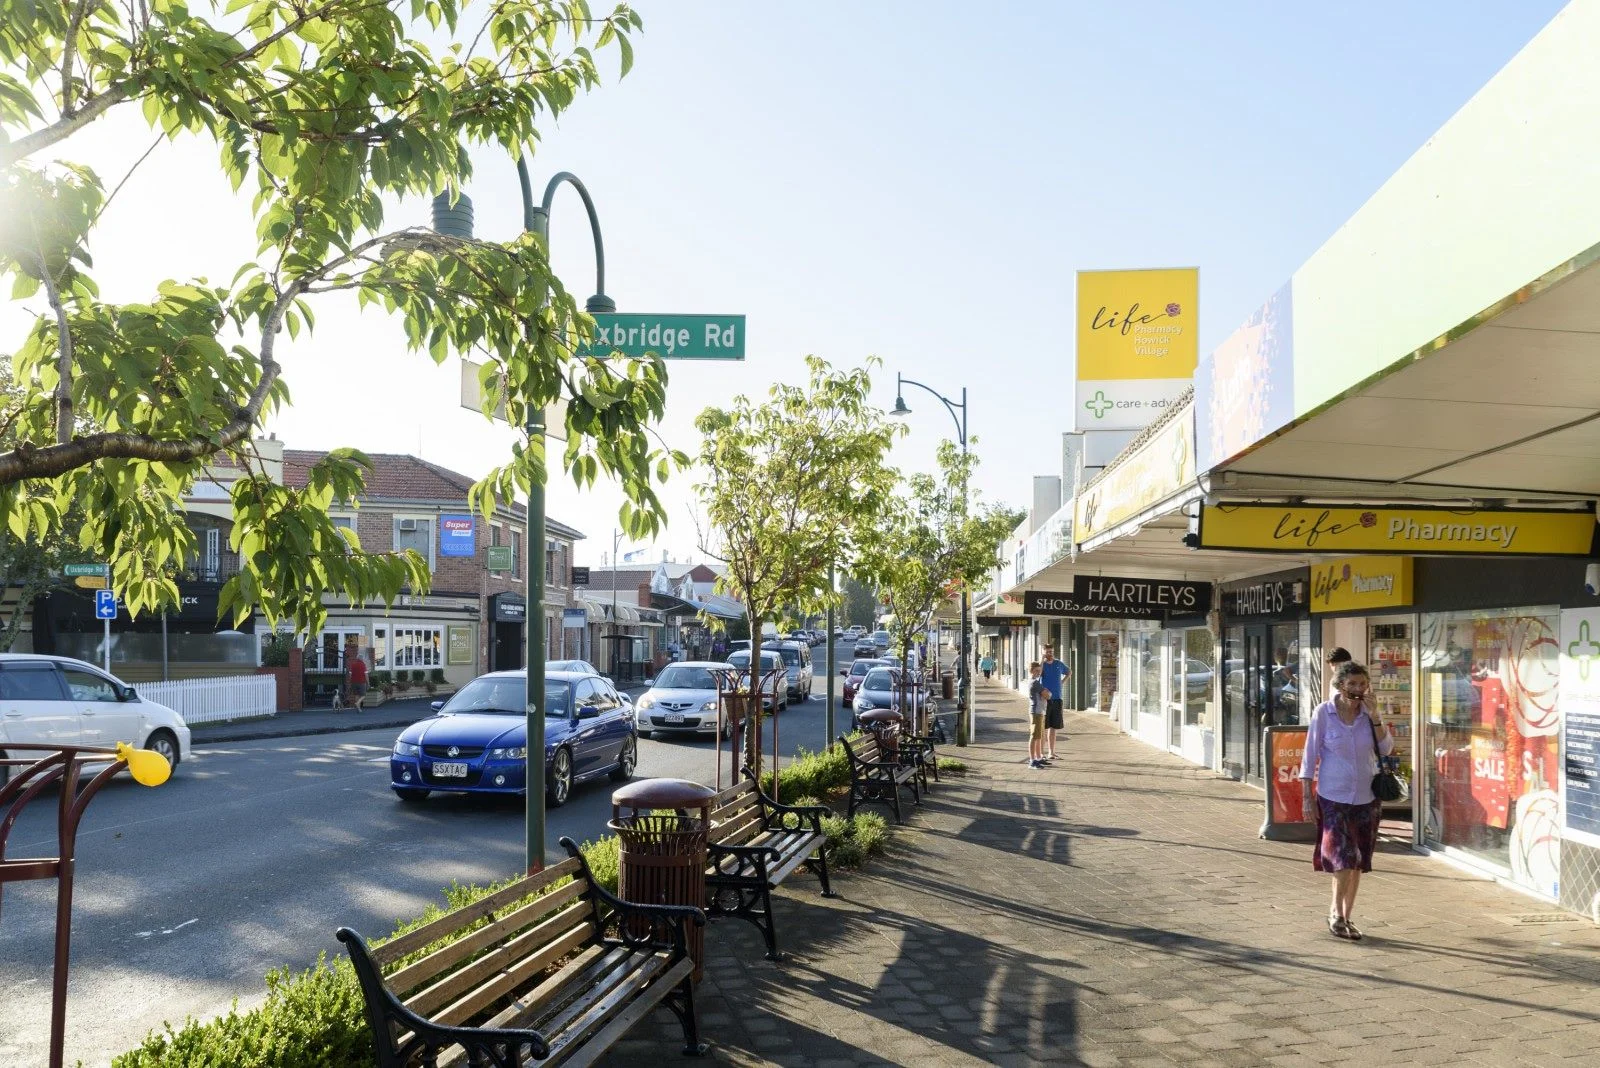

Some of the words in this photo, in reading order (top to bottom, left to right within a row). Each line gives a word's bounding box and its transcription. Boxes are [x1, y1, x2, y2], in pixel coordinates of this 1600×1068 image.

[1092, 303, 1166, 335] life
[1134, 326, 1182, 336] Pharmacy
[597, 322, 690, 354] xbridge
[705, 323, 735, 347] Rd
[1134, 346, 1169, 357] Village
[1151, 399, 1173, 408] adv
[445, 521, 470, 529] Super
[1273, 510, 1360, 546] life
[1388, 517, 1517, 548] Pharmacy
[1088, 581, 1196, 606] HARTLEYS
[1313, 565, 1344, 605] life
[1352, 574, 1394, 596] Pharmacy
[1036, 598, 1080, 611] SHOES
[1236, 581, 1283, 615] HARTLEYS
[1279, 748, 1294, 757] BIG
[1474, 757, 1505, 781] SALE
